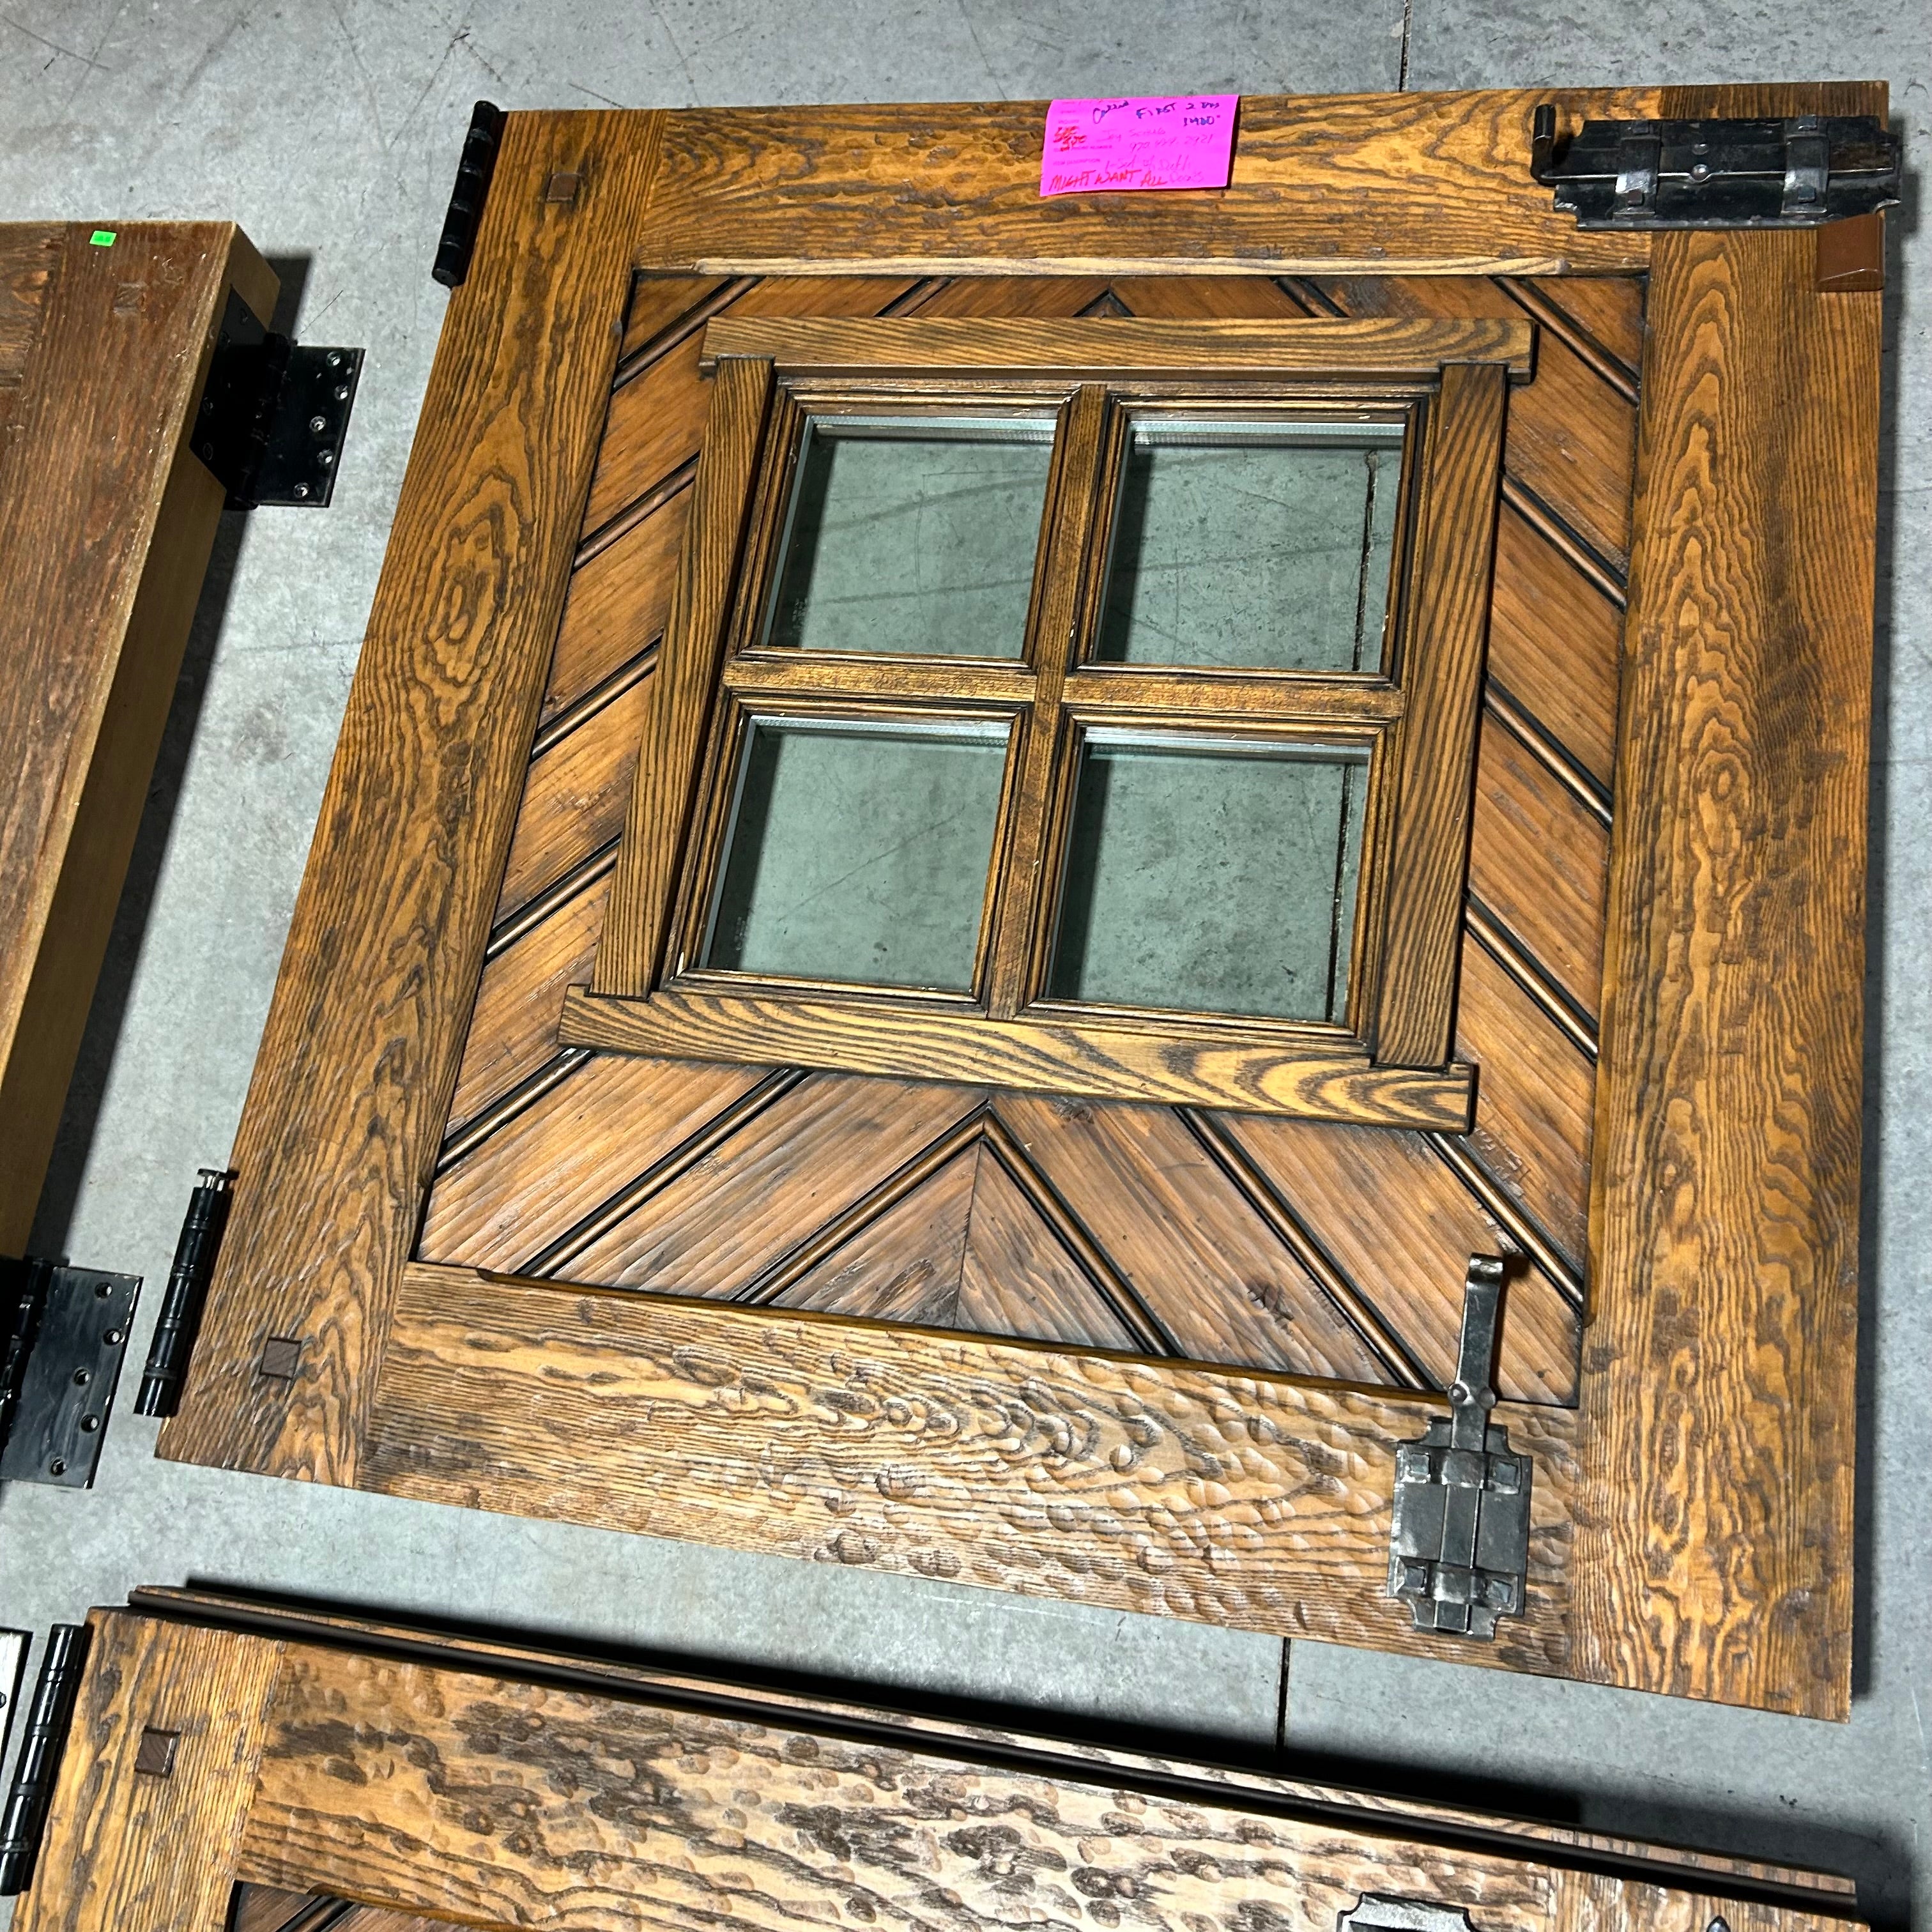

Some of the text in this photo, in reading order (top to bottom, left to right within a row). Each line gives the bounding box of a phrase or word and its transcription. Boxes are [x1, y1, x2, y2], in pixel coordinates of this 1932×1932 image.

[1048, 169, 1167, 191] MIGHT WANT ALL
